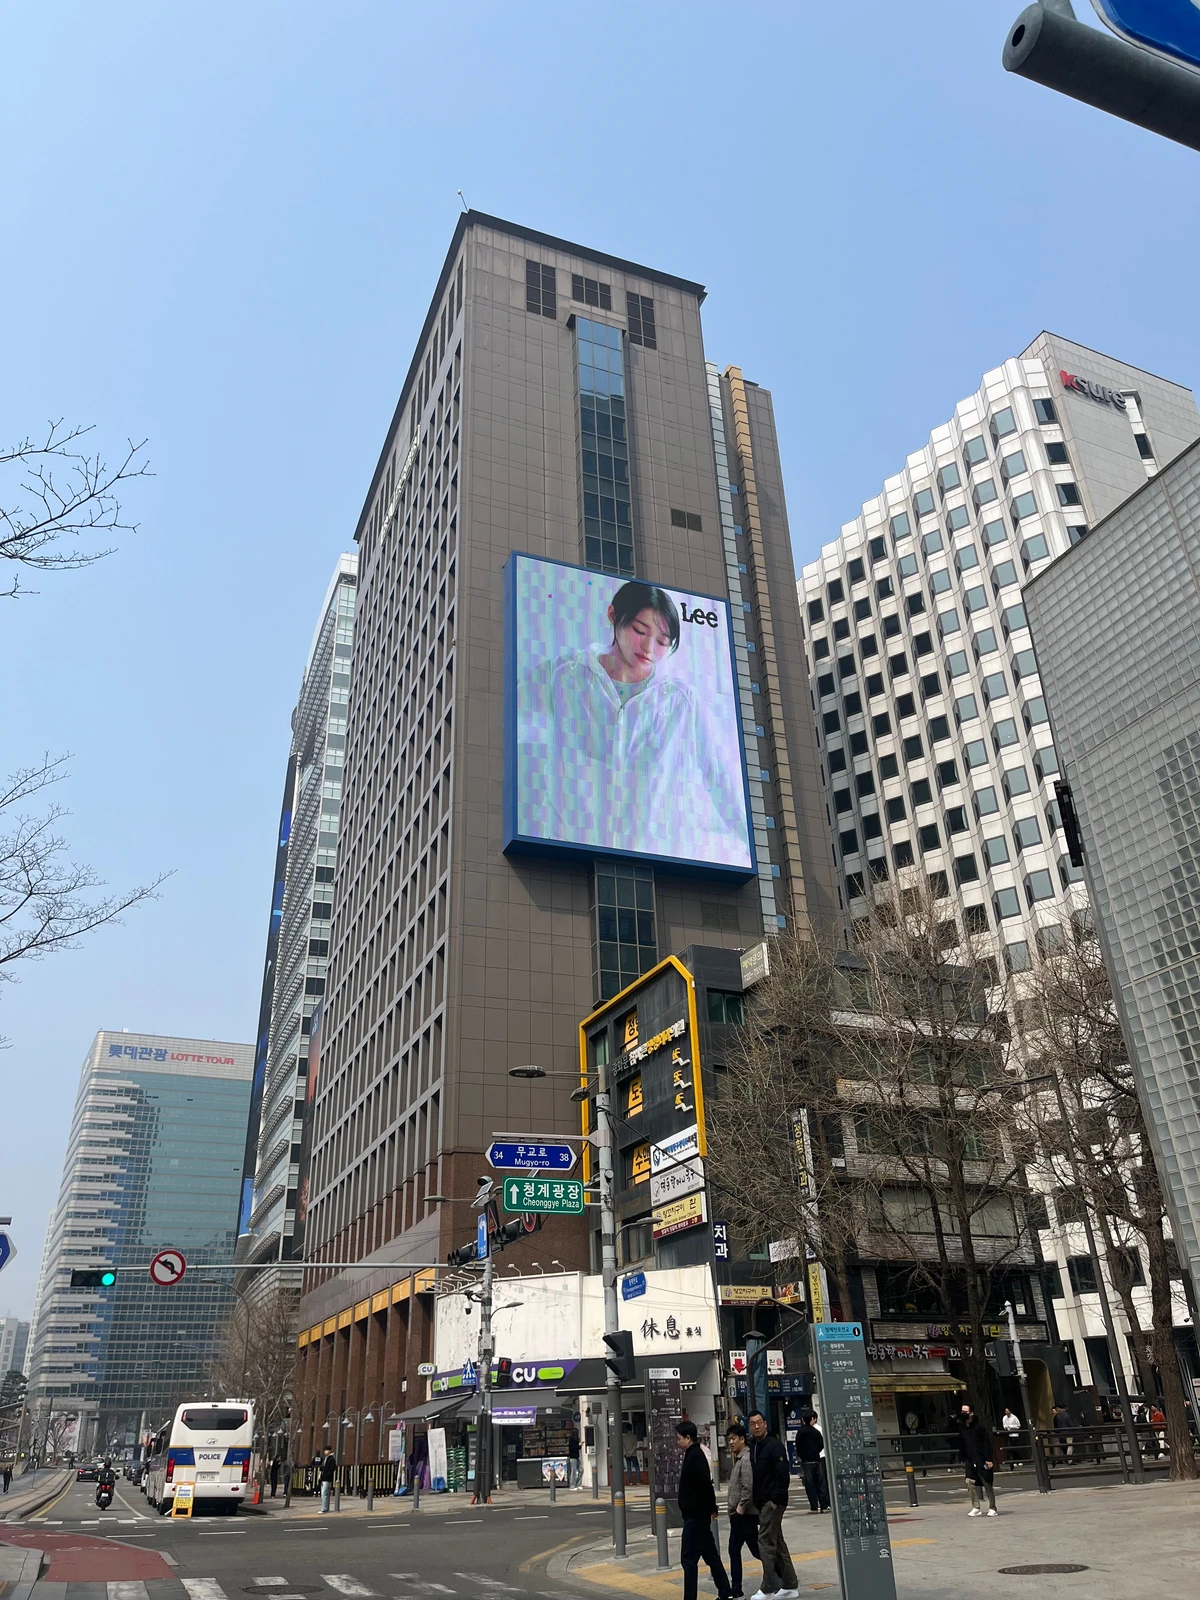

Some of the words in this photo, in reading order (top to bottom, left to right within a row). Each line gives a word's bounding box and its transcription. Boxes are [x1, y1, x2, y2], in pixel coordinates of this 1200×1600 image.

[680, 602, 718, 628] Lee
[108, 1044, 168, 1062] 롯데관광
[170, 1052, 204, 1063] LOTTE
[205, 1055, 235, 1065] TOUR
[632, 1081, 643, 1101] 도
[493, 1151, 504, 1160] 34
[516, 1146, 548, 1157] 무교로
[559, 1153, 569, 1162] 38
[514, 1158, 550, 1167] Mugyo-ro
[523, 1182, 580, 1200] 청계광장
[522, 1197, 559, 1209] Cheonggye
[561, 1199, 580, 1208] Plaza
[714, 1225, 728, 1258] 치과
[640, 1315, 680, 1340] 休息
[867, 1343, 930, 1360] 명동할머니국수
[421, 1365, 433, 1373] CU
[512, 1367, 536, 1383] CU
